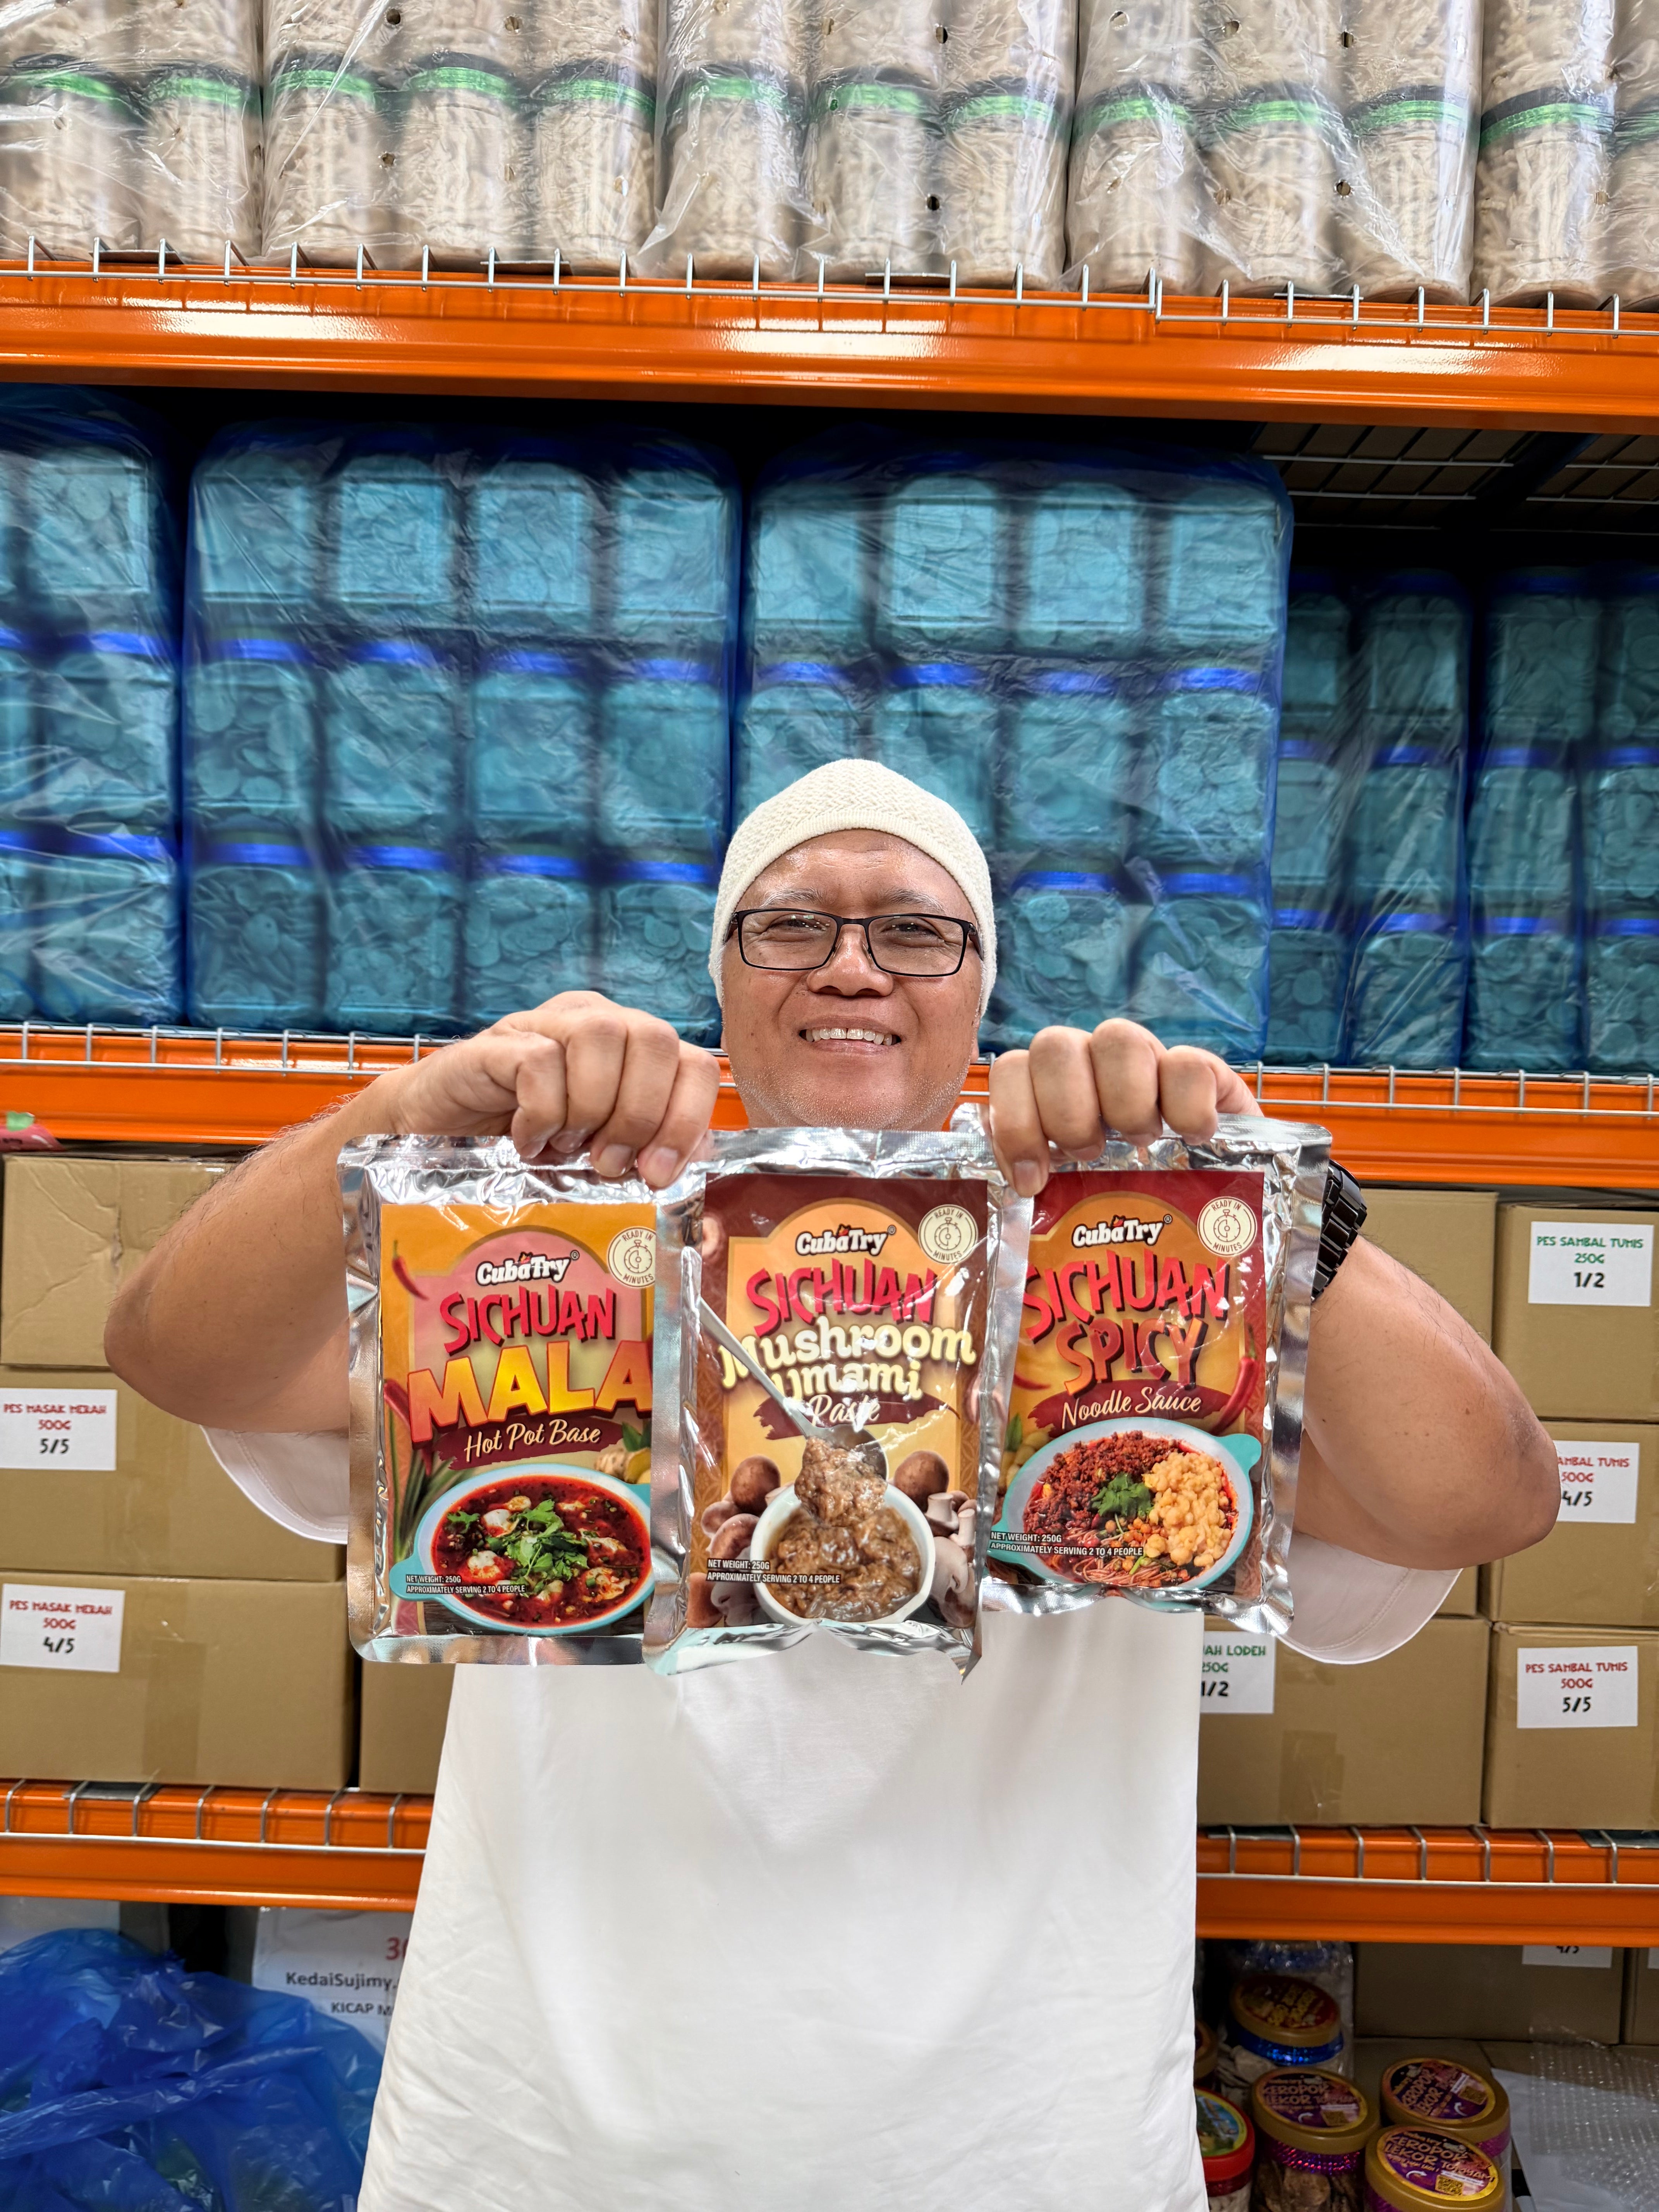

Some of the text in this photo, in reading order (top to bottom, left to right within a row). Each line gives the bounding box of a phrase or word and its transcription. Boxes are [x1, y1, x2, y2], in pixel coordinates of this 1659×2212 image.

[1211, 1200, 1241, 1211] READY IN
[934, 1208, 963, 1219] READY IN
[622, 1230, 654, 1241] READY IN
[1073, 1219, 1163, 1246] CubaTry
[796, 1228, 887, 1255] CubaTry
[1213, 1242, 1242, 1252] MINUTES
[1537, 1236, 1643, 1248] PES SAMBAL TUMIS
[933, 1250, 962, 1261] MINUTES
[1574, 1253, 1604, 1264] 250G
[477, 1255, 570, 1285] CubaTry
[623, 1273, 654, 1284] MINUTES
[1574, 1272, 1605, 1288] 1/2
[746, 1258, 937, 1338] SICHUAN
[1022, 1249, 1230, 1344] SICHUAN
[440, 1284, 616, 1355] SICHUAN
[1055, 1318, 1208, 1395] SPICY
[407, 1341, 652, 1443] MALA
[3, 1403, 22, 1413] PES
[1062, 1386, 1202, 1429] Noodle Sauce
[38, 1419, 72, 1430] 500G
[40, 1437, 70, 1454] 5/5
[464, 1419, 600, 1463] Hot Pot Base
[1558, 1456, 1630, 1468] AMBAL TUMIS
[1561, 1472, 1594, 1483] 500G
[1562, 1490, 1593, 1507] 4/5
[1008, 1533, 1039, 1542] WEIGHT:
[1042, 1534, 1061, 1542] 250G
[991, 1543, 1053, 1554] APPROXIMATELY
[708, 1559, 721, 1568] NET
[723, 1560, 750, 1569] WEIGHT:
[708, 1572, 840, 1583] APPROXIMATELY SERVING 2 TO 4 PEOPLE
[9, 1600, 28, 1610] PES
[31, 1601, 72, 1613] MASAK
[42, 1617, 77, 1630] 500G
[43, 1636, 75, 1654] 4/5
[1226, 1645, 1266, 1656] LODEH
[1525, 1662, 1628, 1673] PES SAMBAL TUMIS
[1201, 1680, 1229, 1697] 1/2
[1561, 1678, 1594, 1689] 500G
[1562, 1696, 1592, 1713] 5/5
[331, 2002, 374, 2014] KICAP
[1384, 2142, 1438, 2166] LEKOR
[1385, 2136, 1468, 2164] KEROPOK
